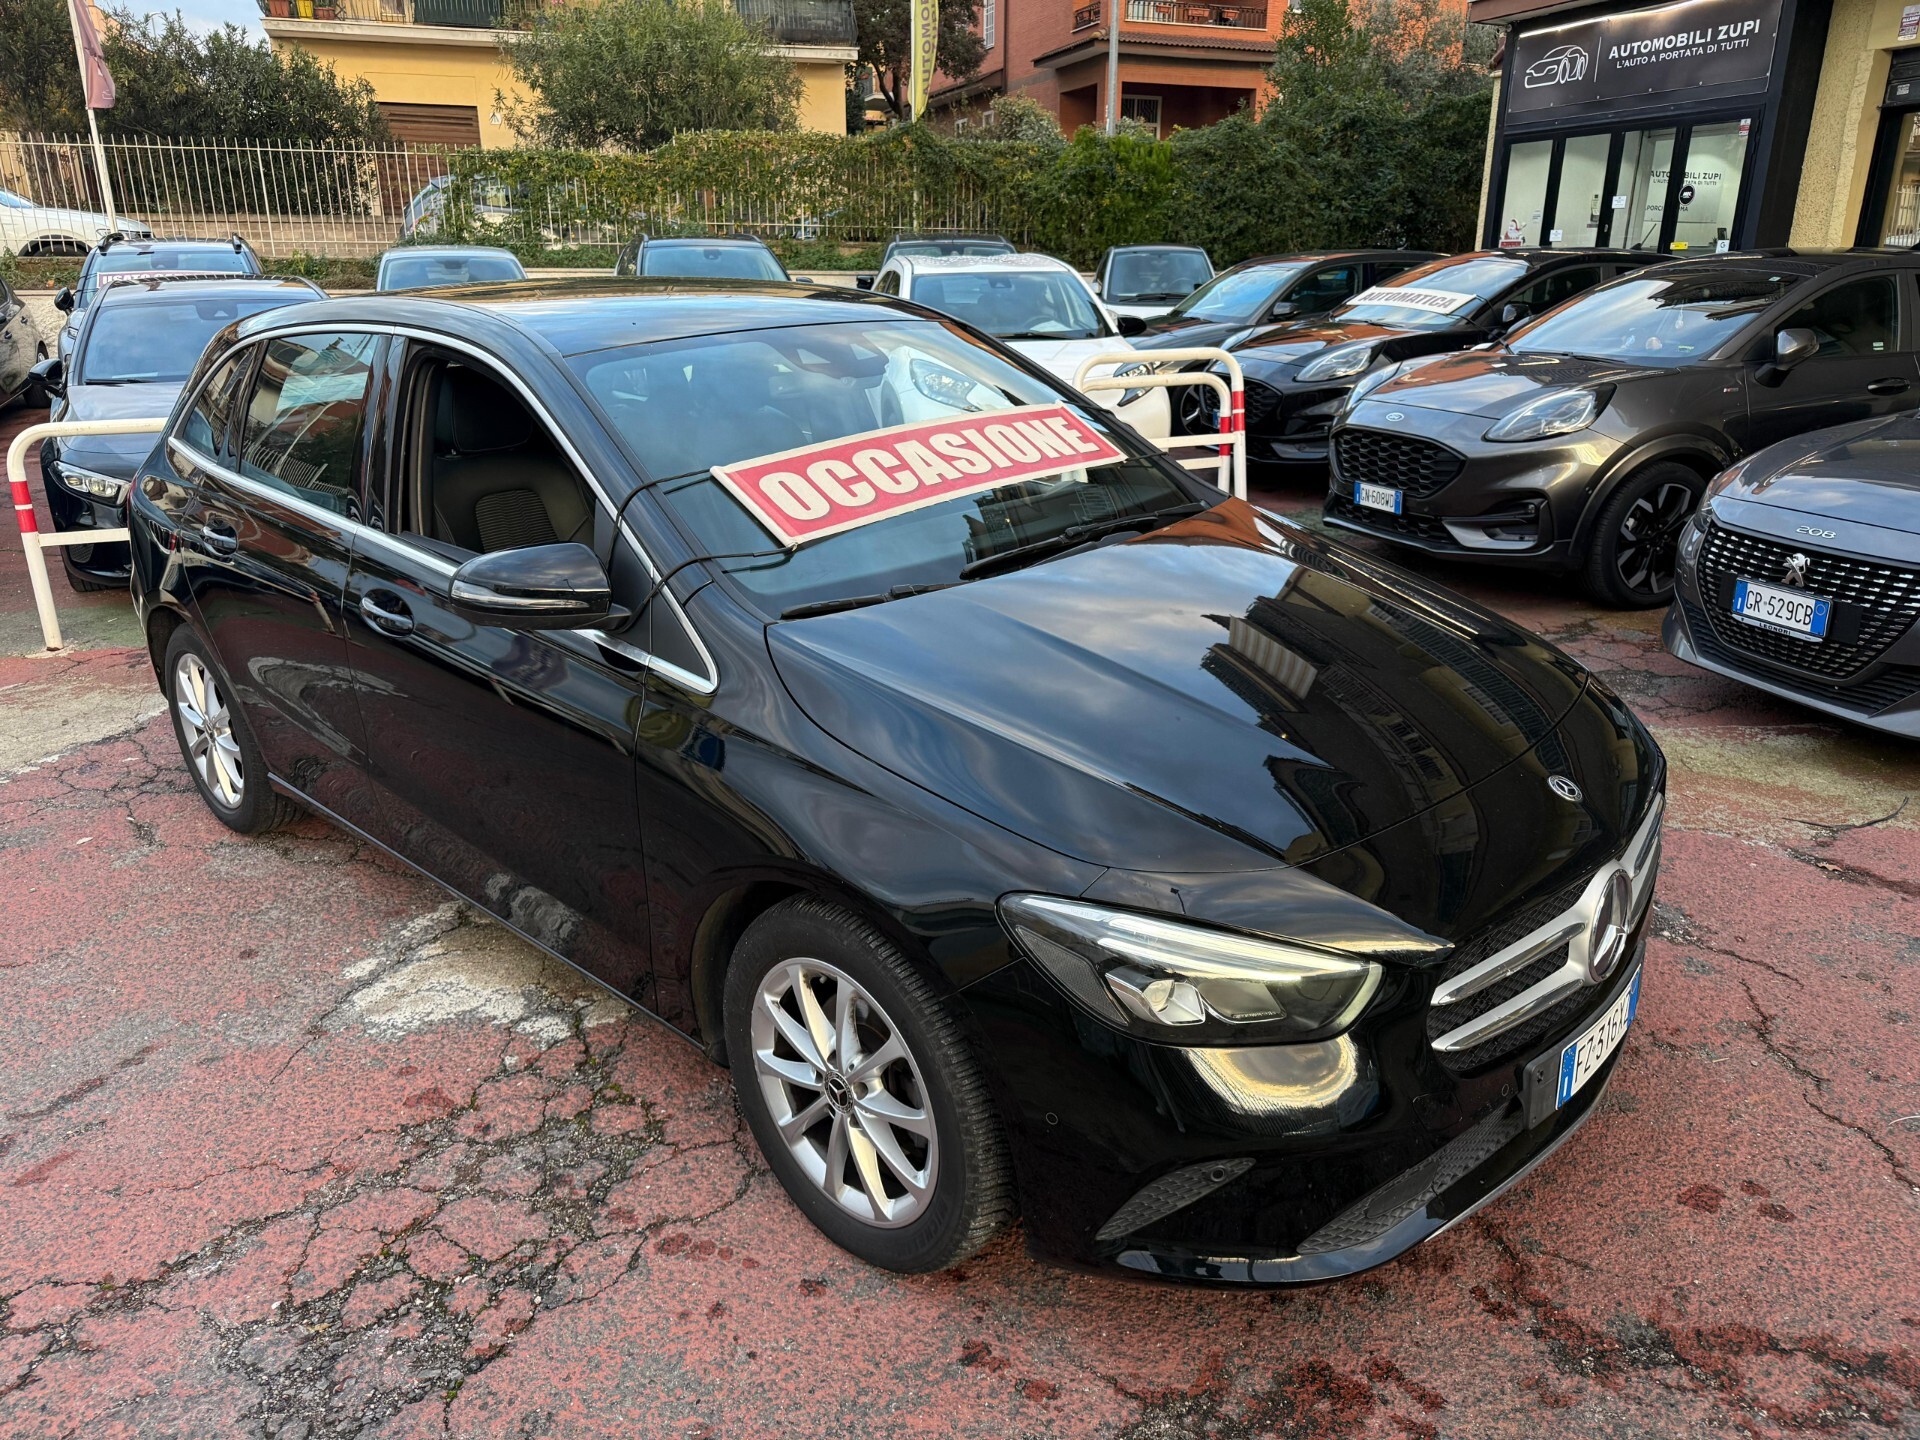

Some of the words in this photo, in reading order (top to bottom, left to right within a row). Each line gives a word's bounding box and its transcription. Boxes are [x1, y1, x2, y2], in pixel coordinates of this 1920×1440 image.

[921, 0, 931, 95] AUTOMO
[1608, 28, 1712, 59] AUTOMOBILI
[1717, 19, 1760, 40] ZUPI
[1616, 56, 1648, 69] L'AUTO
[1650, 54, 1656, 63] A
[1659, 46, 1704, 61] PORTATA
[1707, 44, 1717, 53] DI
[1721, 38, 1750, 51] TUTTI
[1651, 171, 1700, 179] AUTOBILI
[1703, 172, 1722, 180] ZUPI
[1357, 292, 1457, 309] AUTOMATICA
[758, 416, 1101, 521] OCCASIONE
[1796, 525, 1837, 538] 208
[1759, 622, 1791, 636] LEONORI
